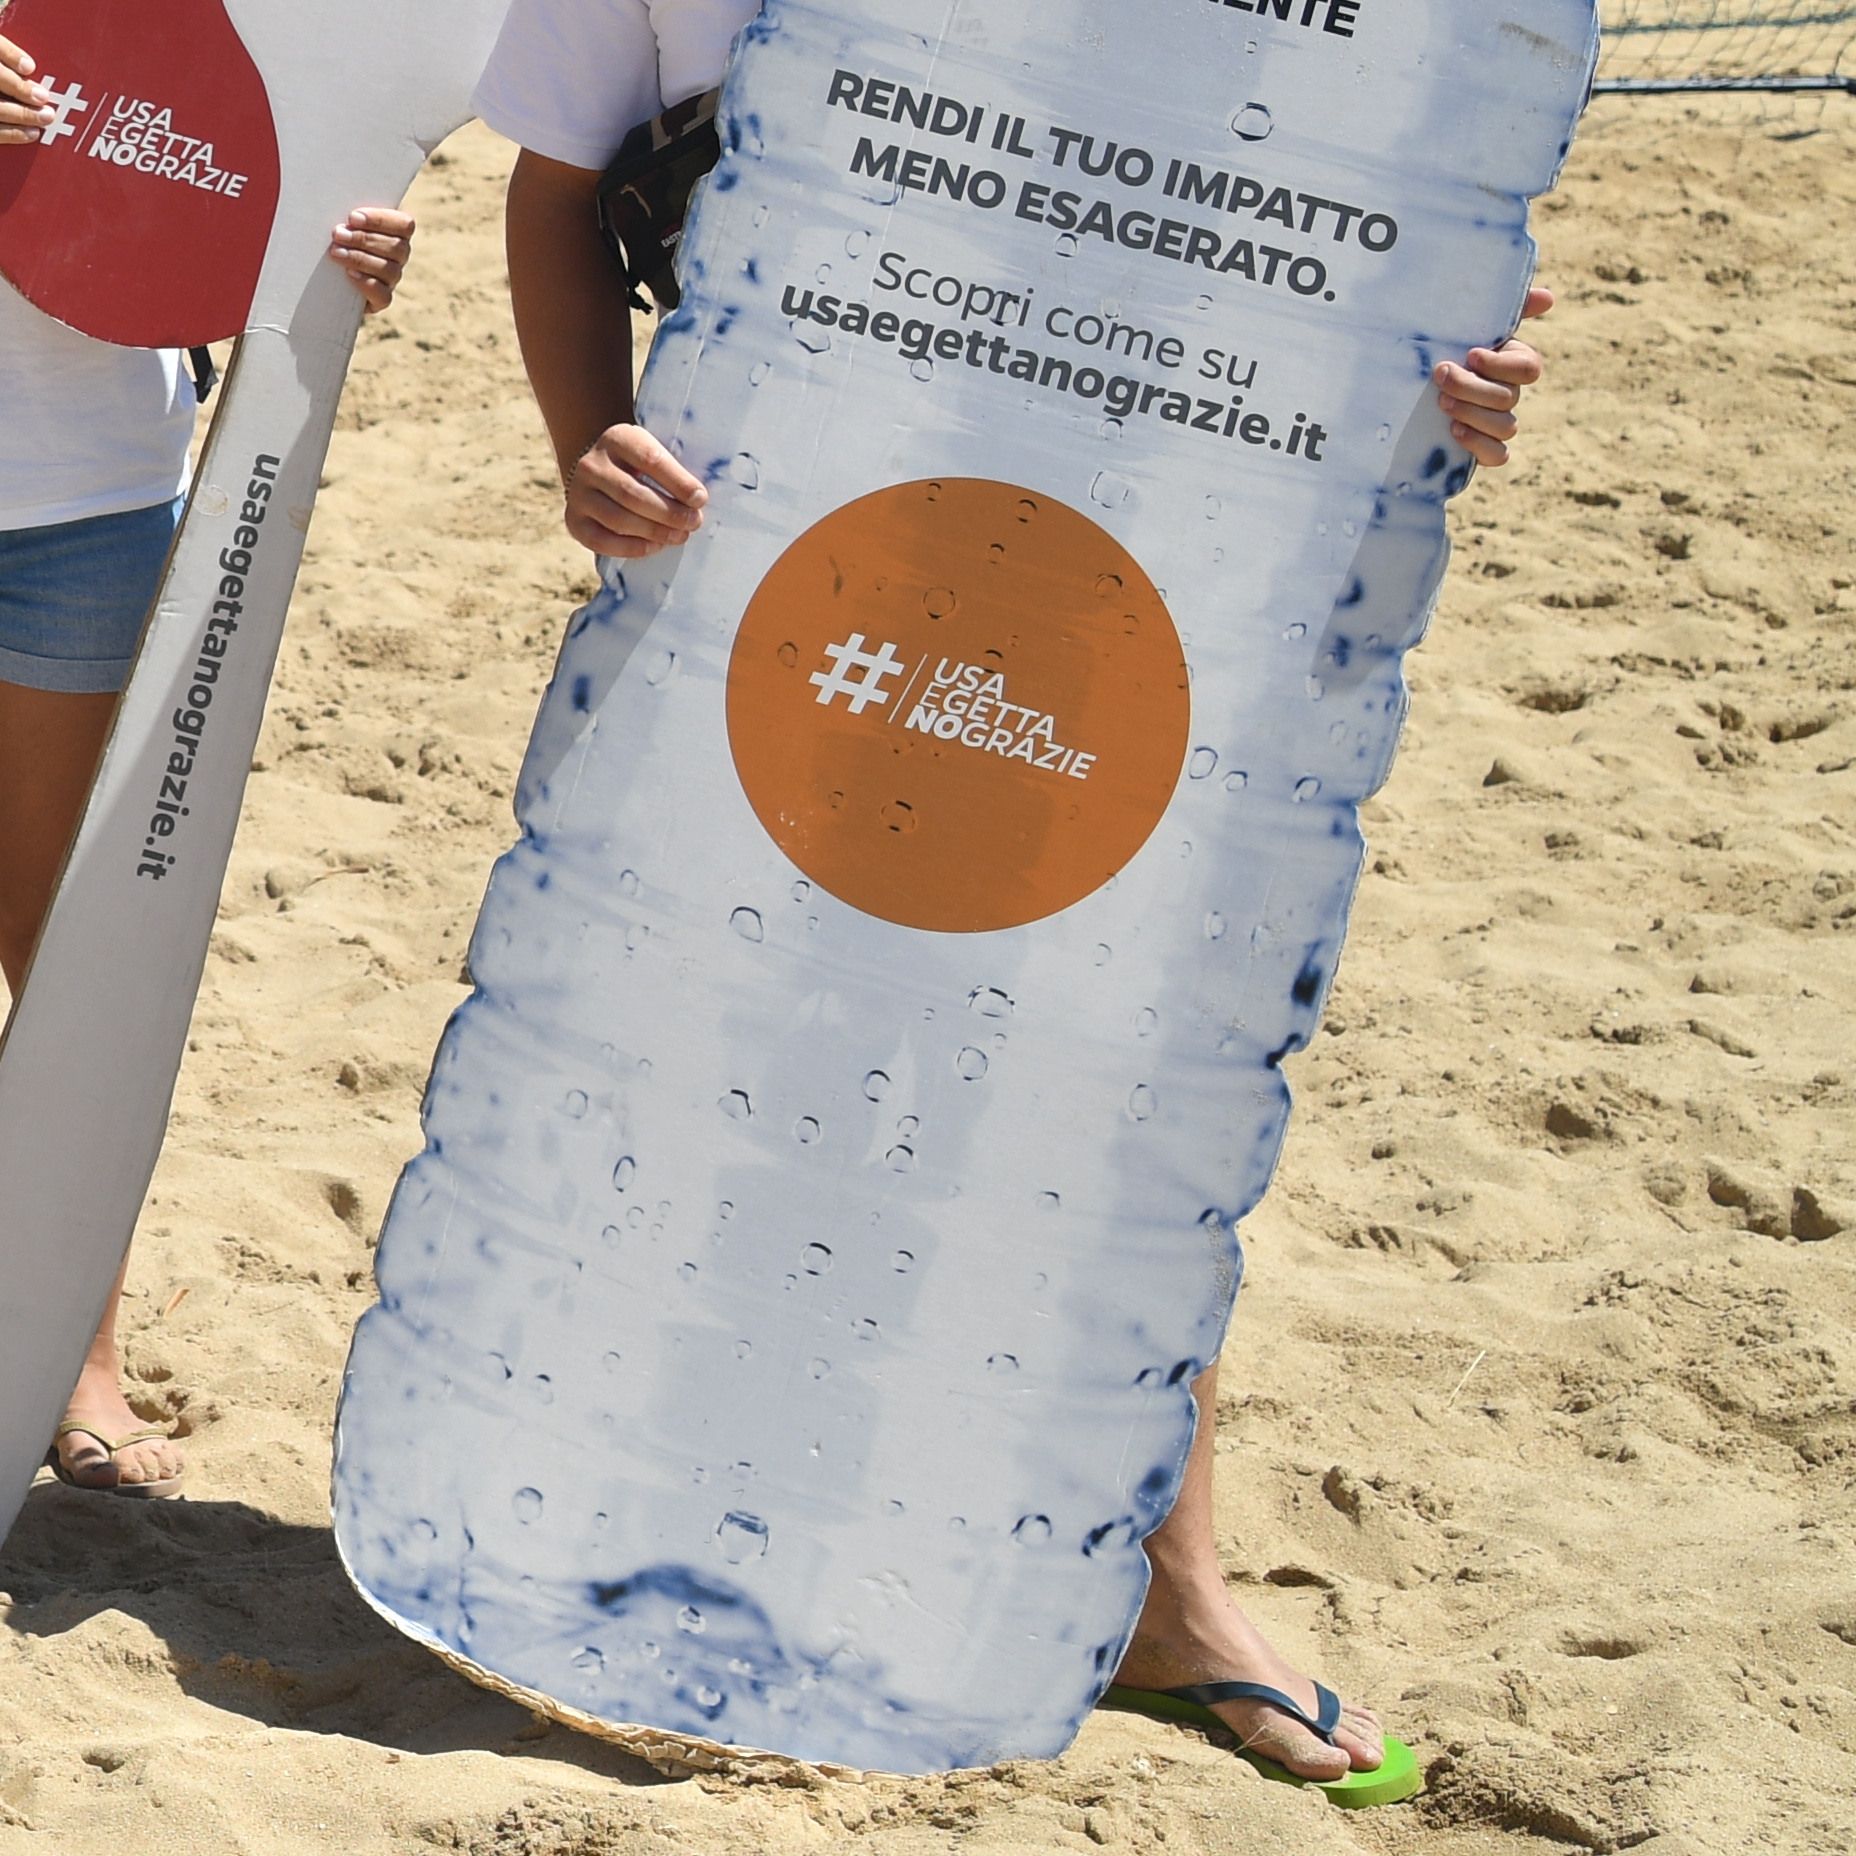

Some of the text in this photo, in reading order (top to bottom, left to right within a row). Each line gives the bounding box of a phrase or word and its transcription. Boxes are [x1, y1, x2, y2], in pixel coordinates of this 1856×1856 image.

[112, 95, 173, 132] USA
[826, 68, 1399, 253] RENDI IL TUO IMPATTO
[849, 136, 1337, 302] MENO ESAGERATO.
[779, 284, 1329, 462] usaegettanograzie.it
[872, 251, 1259, 390] Scopri come su
[136, 452, 281, 882] usaegettanograzie.it
[933, 657, 1005, 701] USA
